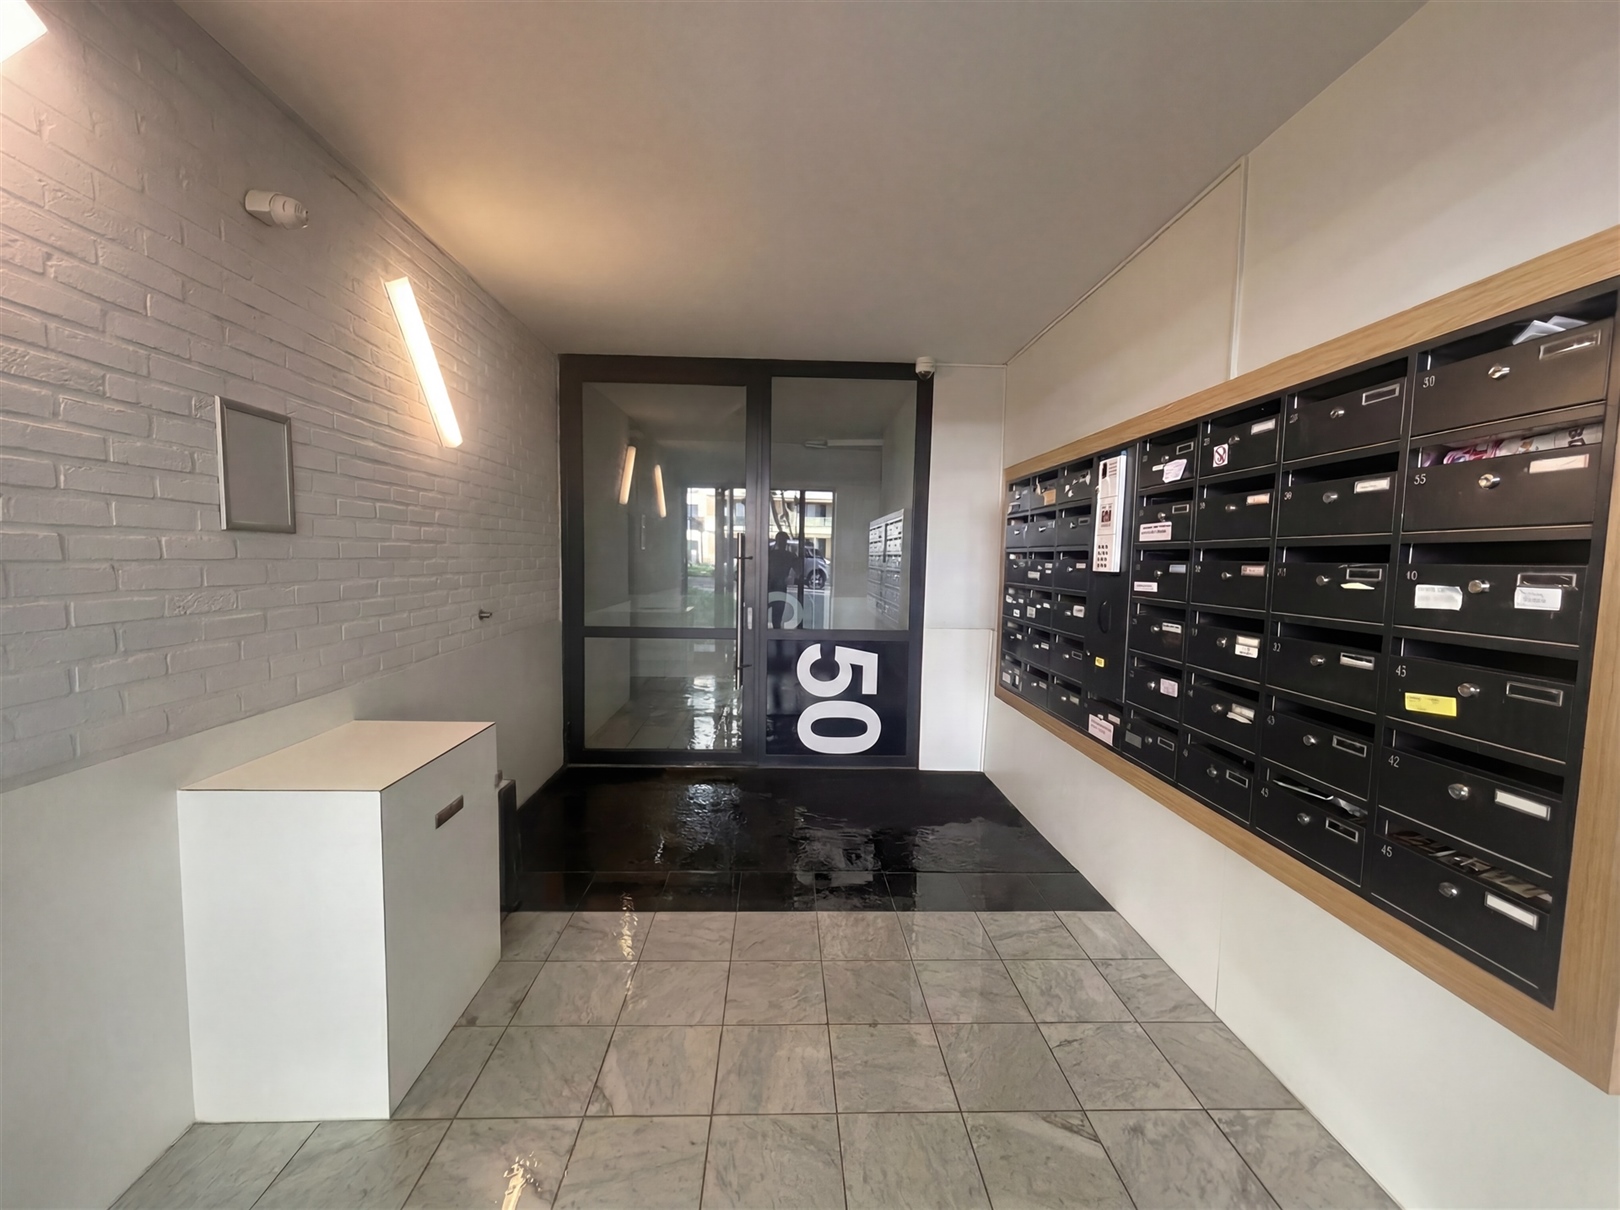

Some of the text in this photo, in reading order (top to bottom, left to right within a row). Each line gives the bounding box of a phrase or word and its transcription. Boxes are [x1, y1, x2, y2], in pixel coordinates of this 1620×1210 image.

[1413, 473, 1427, 485] 55
[796, 643, 882, 755] 50
[1387, 754, 1400, 768] 42
[1380, 844, 1393, 858] 45
